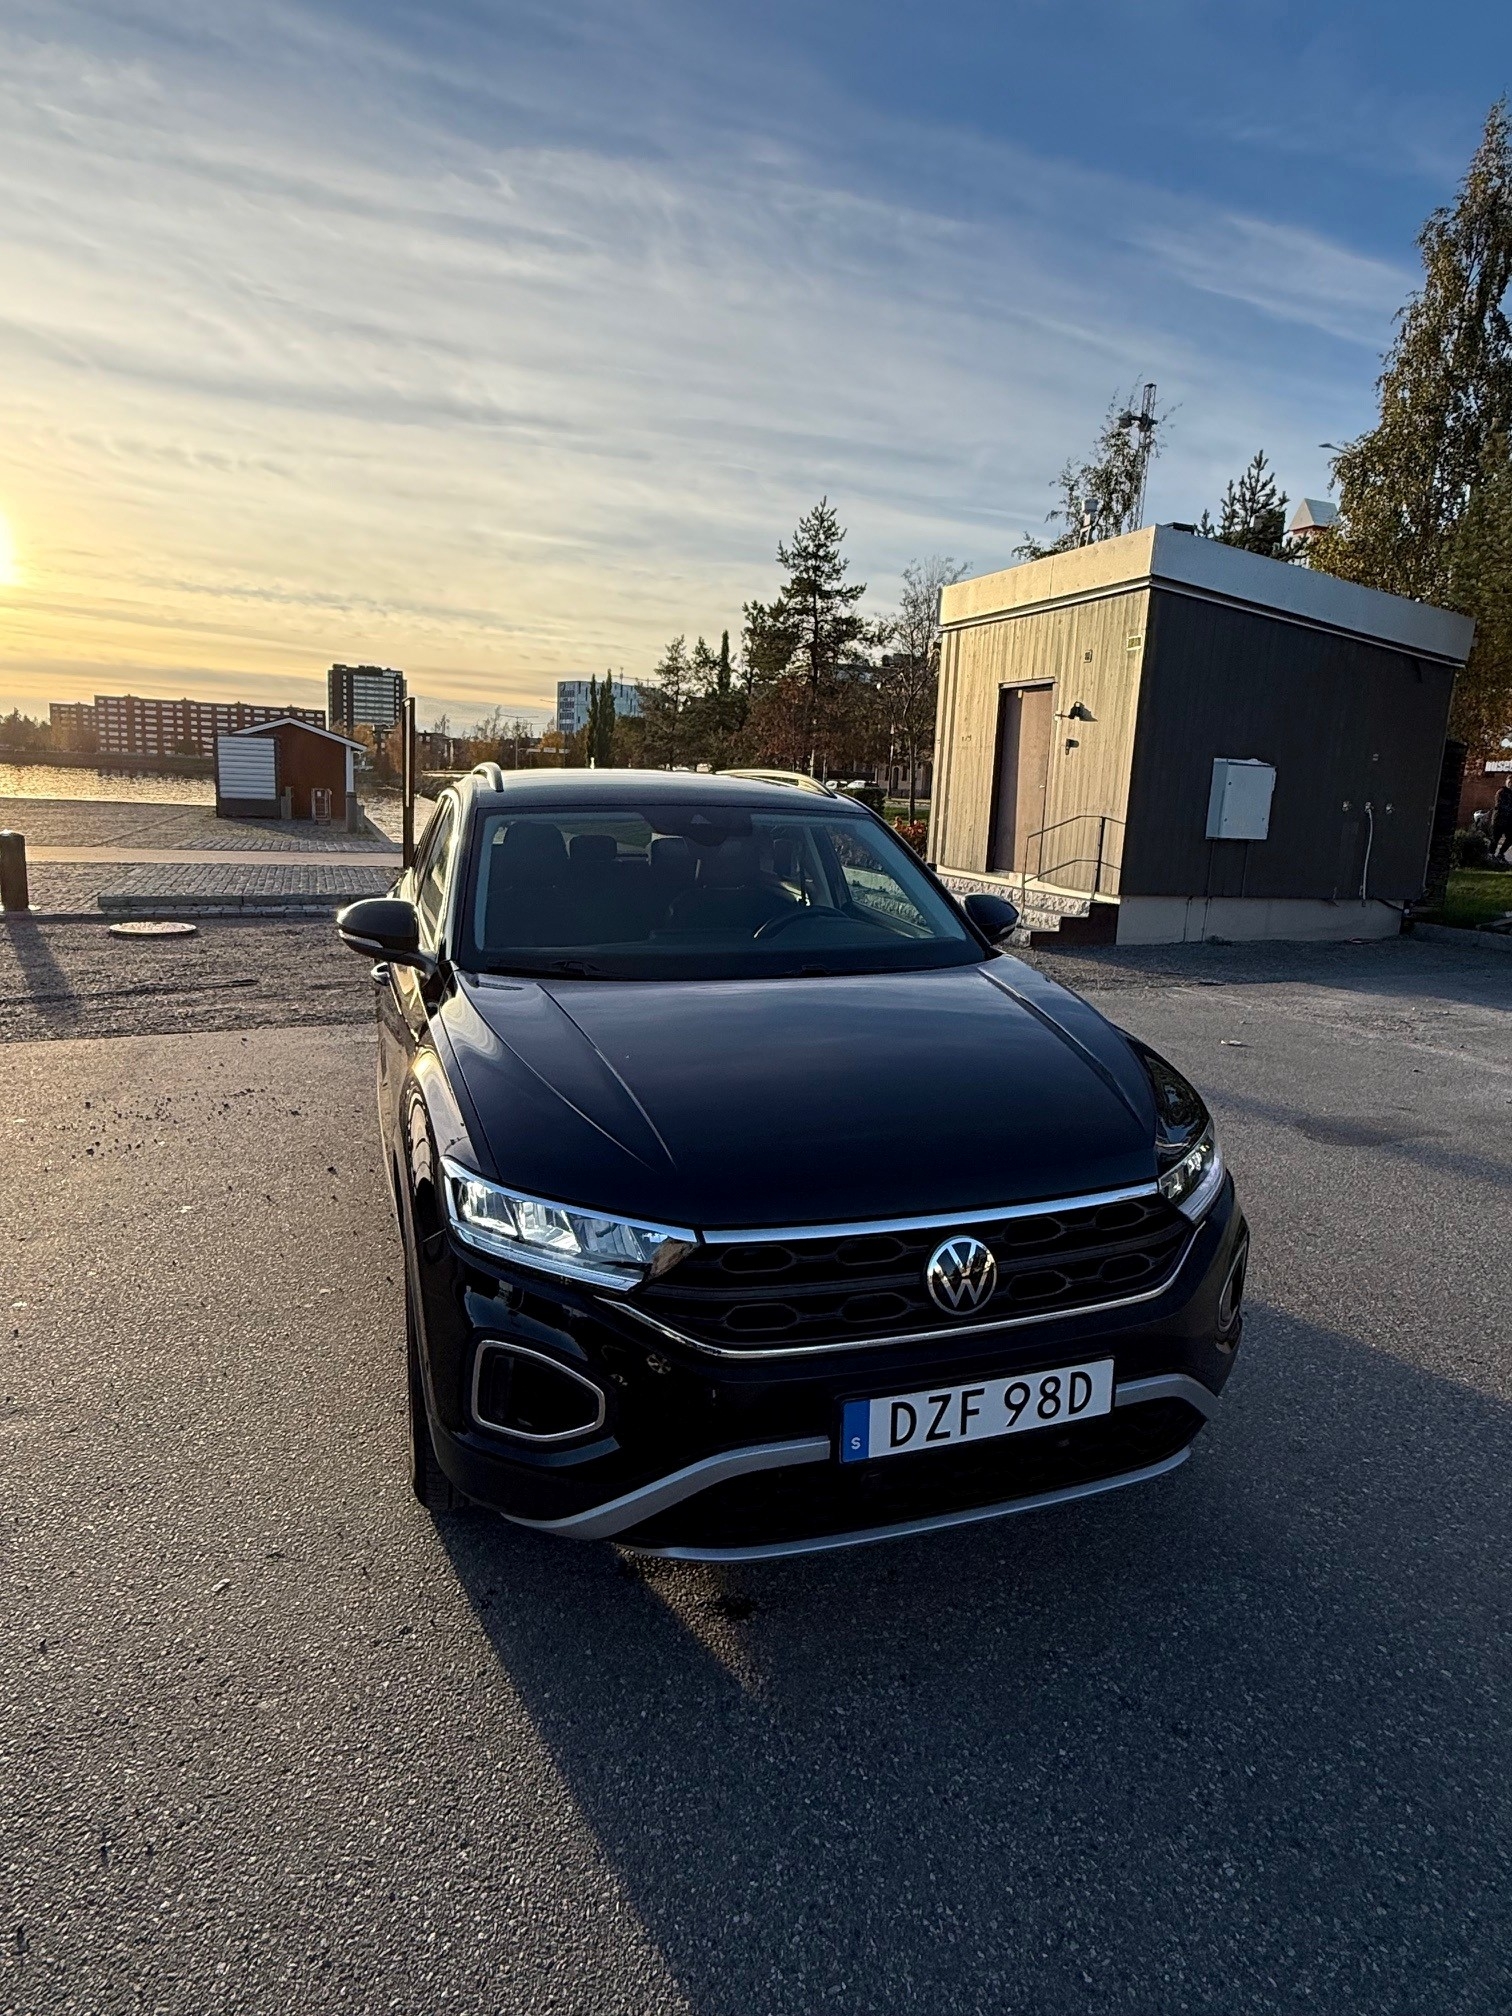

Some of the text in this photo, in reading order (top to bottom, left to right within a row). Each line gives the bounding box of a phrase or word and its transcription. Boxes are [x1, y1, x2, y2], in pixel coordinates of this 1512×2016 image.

[931, 1239, 994, 1310] VW
[851, 1436, 861, 1450] S
[890, 1371, 1092, 1447] DZF 98D
